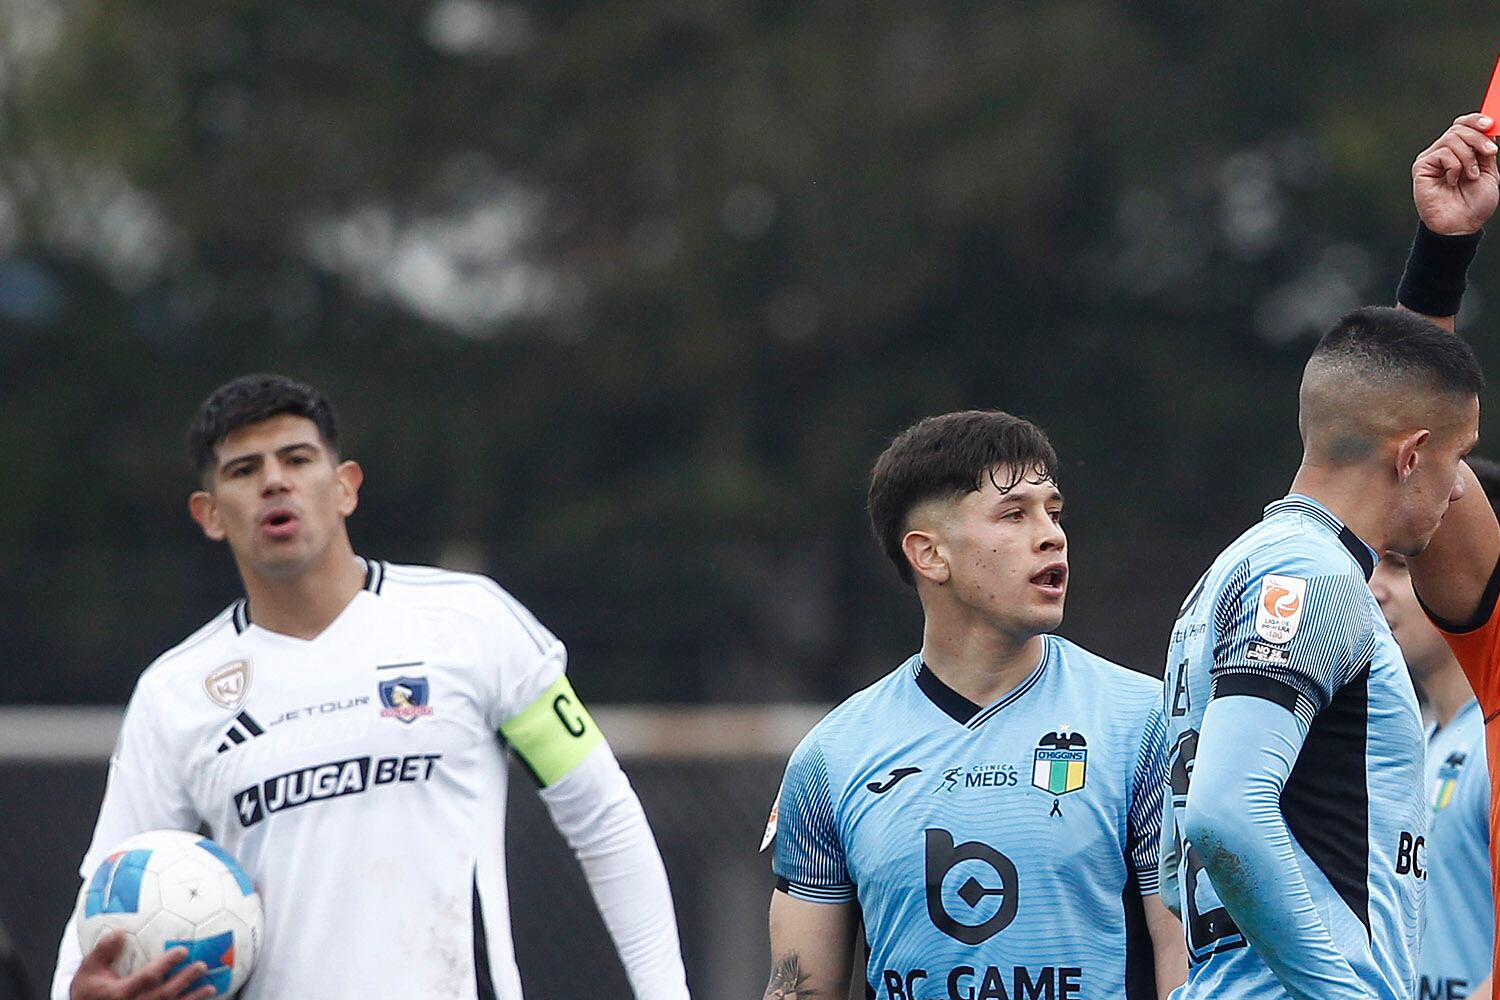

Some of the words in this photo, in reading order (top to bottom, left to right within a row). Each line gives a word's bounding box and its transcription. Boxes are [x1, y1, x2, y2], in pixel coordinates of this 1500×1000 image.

[270, 696, 370, 727] JETOUR
[551, 694, 586, 738] C
[1038, 752, 1083, 760] O'HIGGINS
[965, 771, 1018, 788] MEDS
